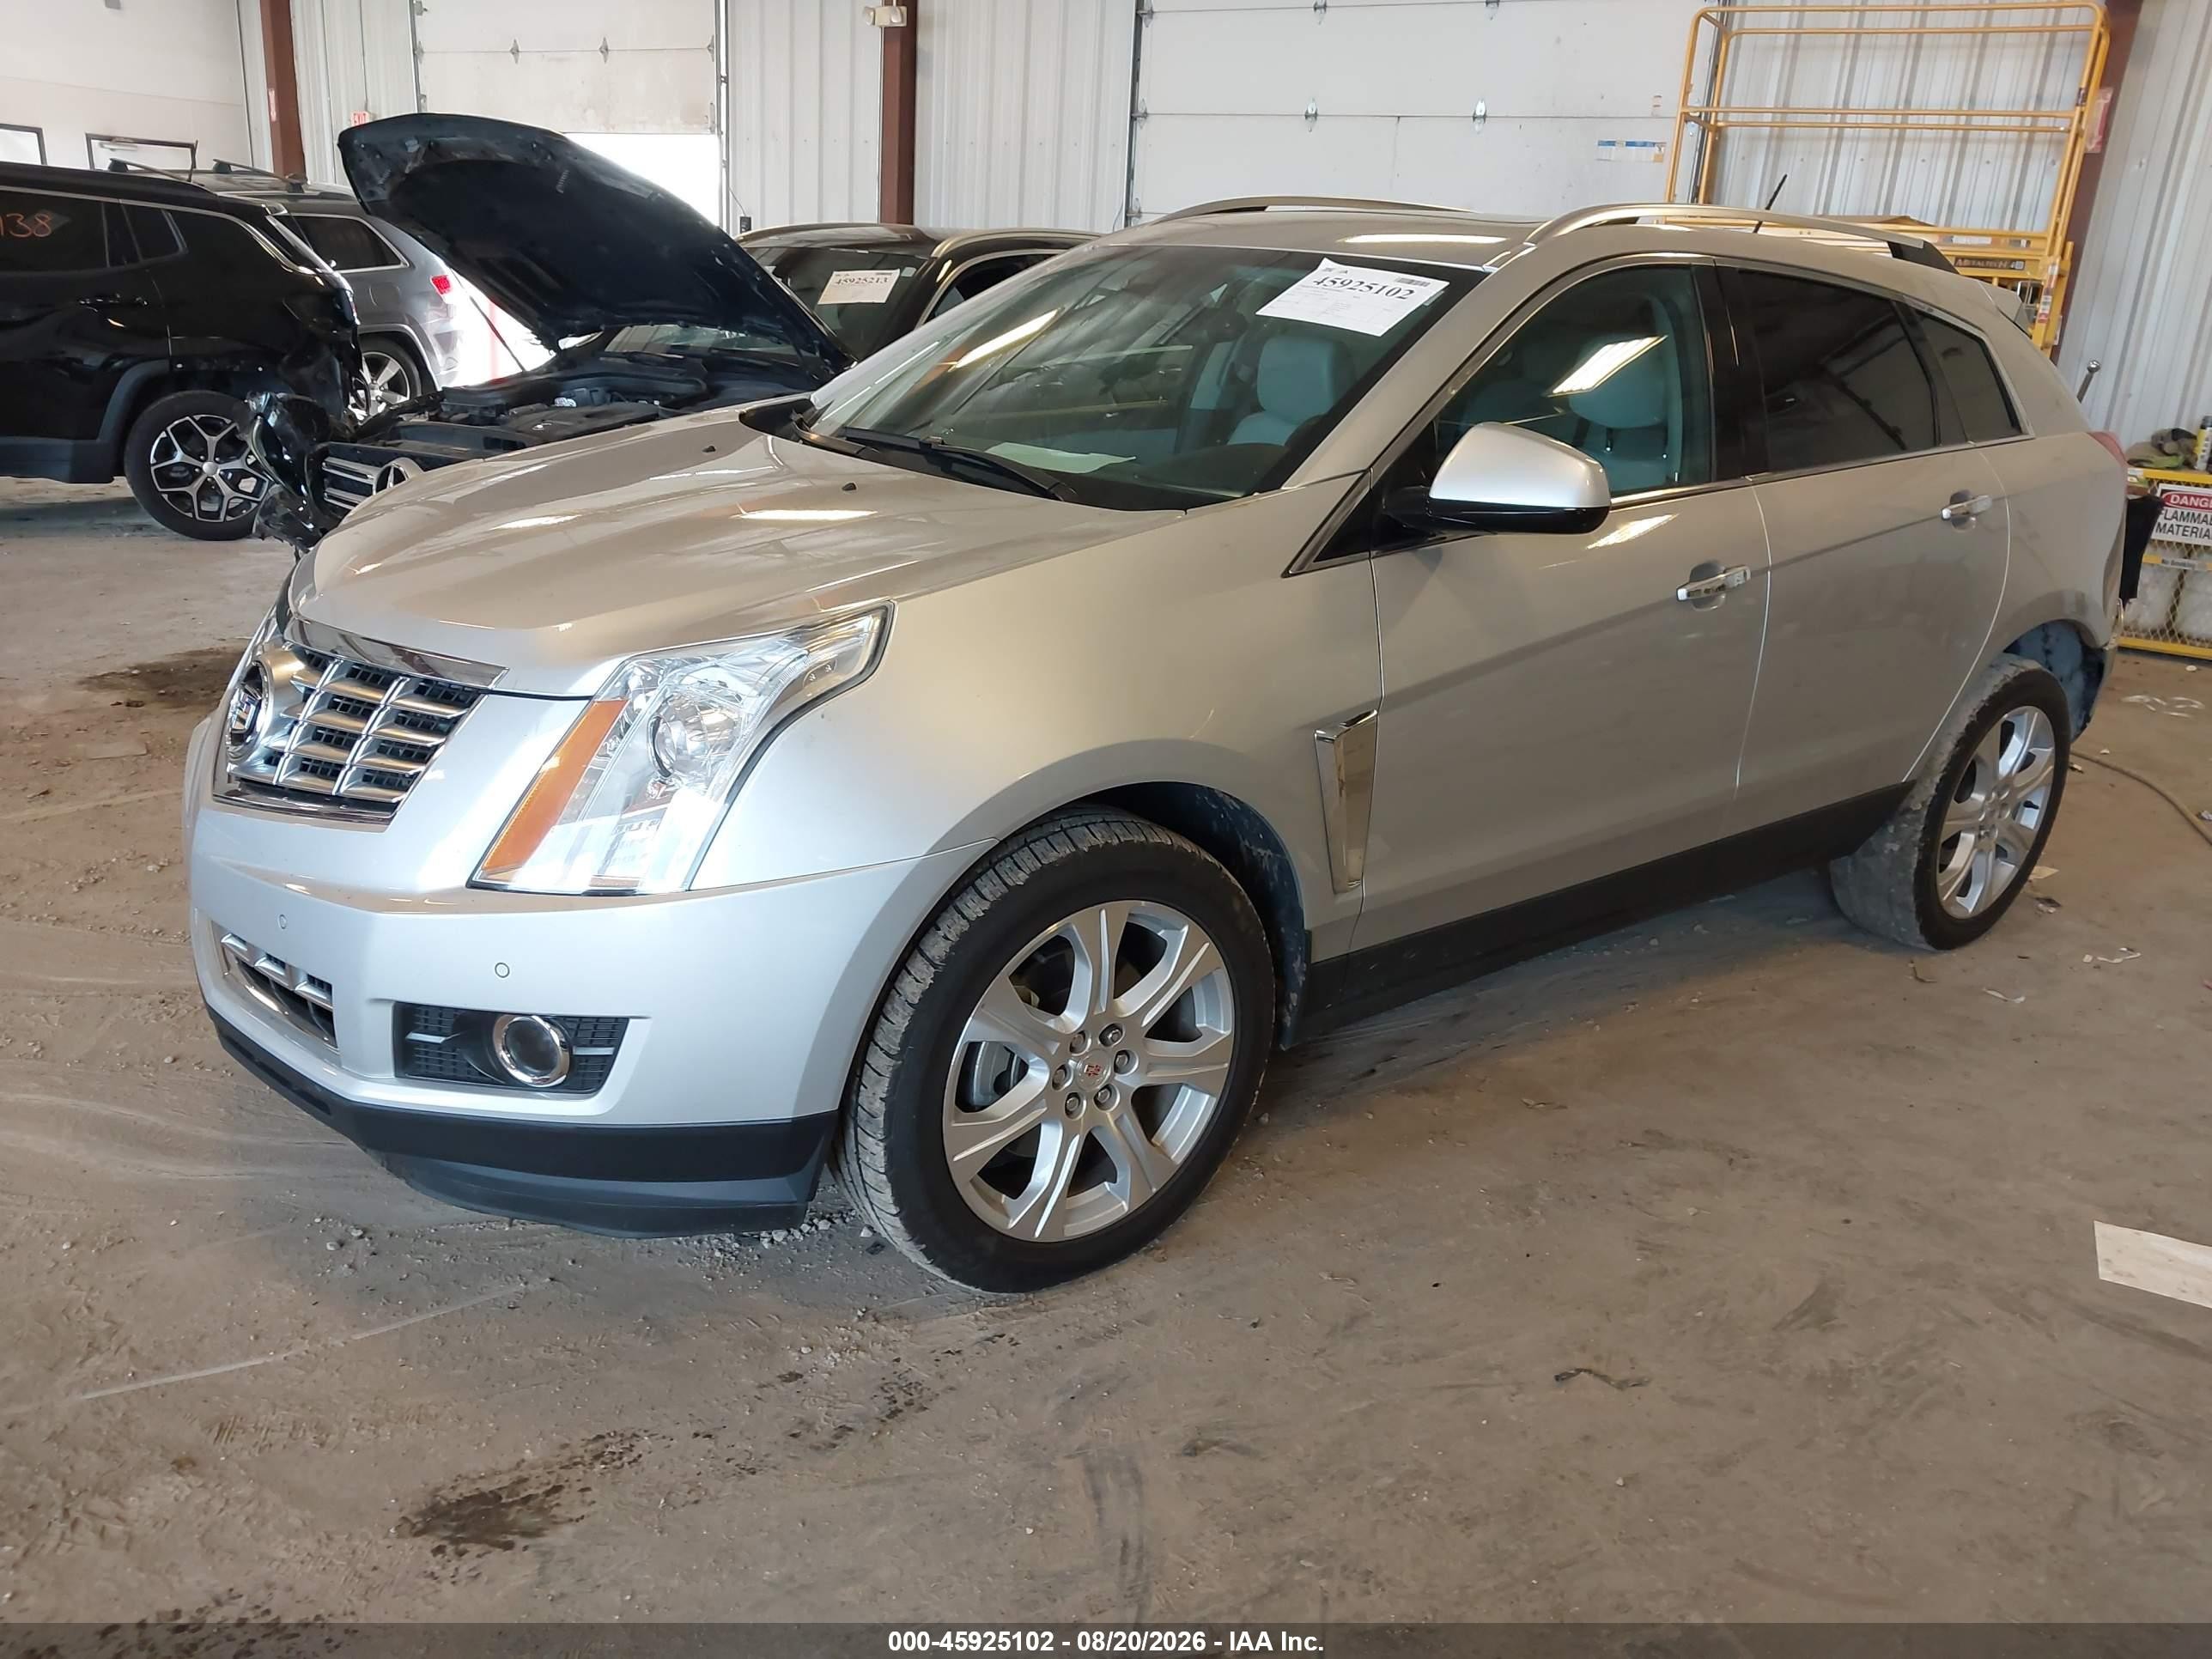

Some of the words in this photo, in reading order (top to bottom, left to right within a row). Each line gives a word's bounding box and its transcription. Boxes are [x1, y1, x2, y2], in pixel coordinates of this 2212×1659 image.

[834, 276, 889, 285] 45925213
[1313, 276, 1415, 300] 45925102
[2161, 508, 2212, 526] LAMMA
